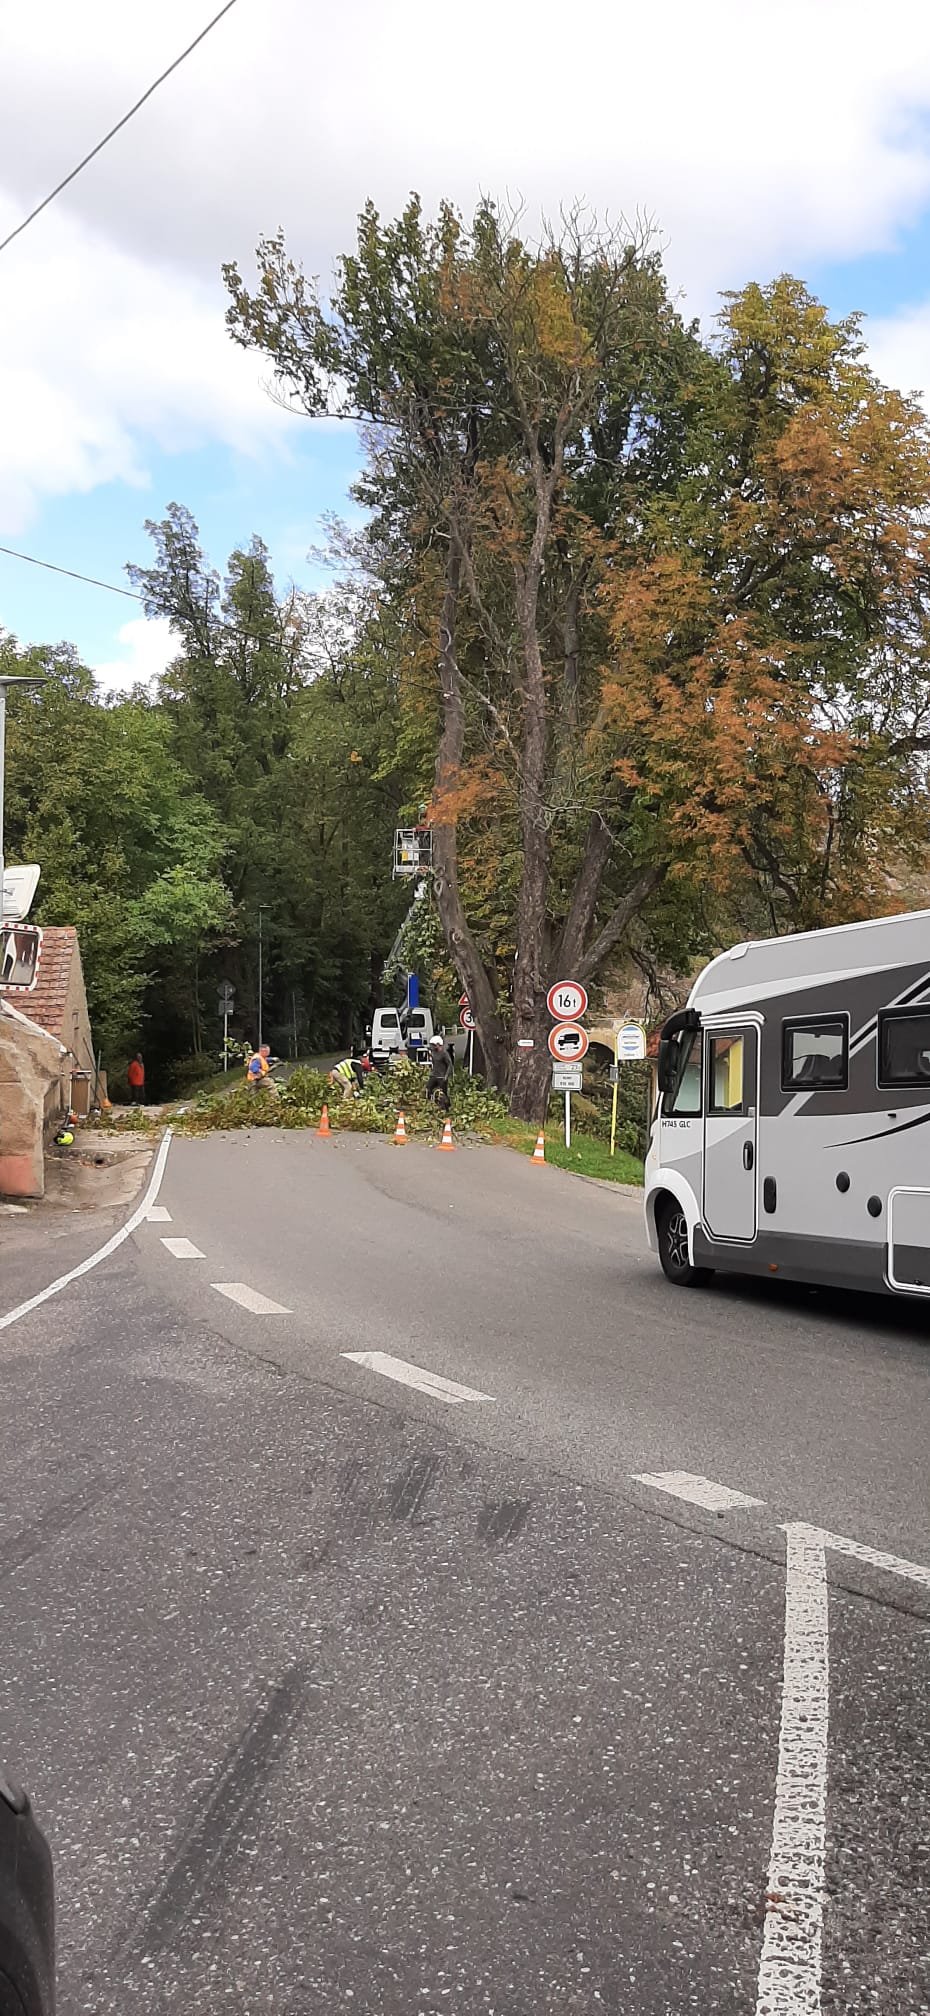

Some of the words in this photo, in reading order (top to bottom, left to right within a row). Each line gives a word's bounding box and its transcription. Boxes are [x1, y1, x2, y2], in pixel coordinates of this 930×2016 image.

[558, 994, 571, 1008] 16
[465, 1012, 474, 1023] 3
[661, 1120, 677, 1128] H745
[679, 1120, 691, 1128] GLC
